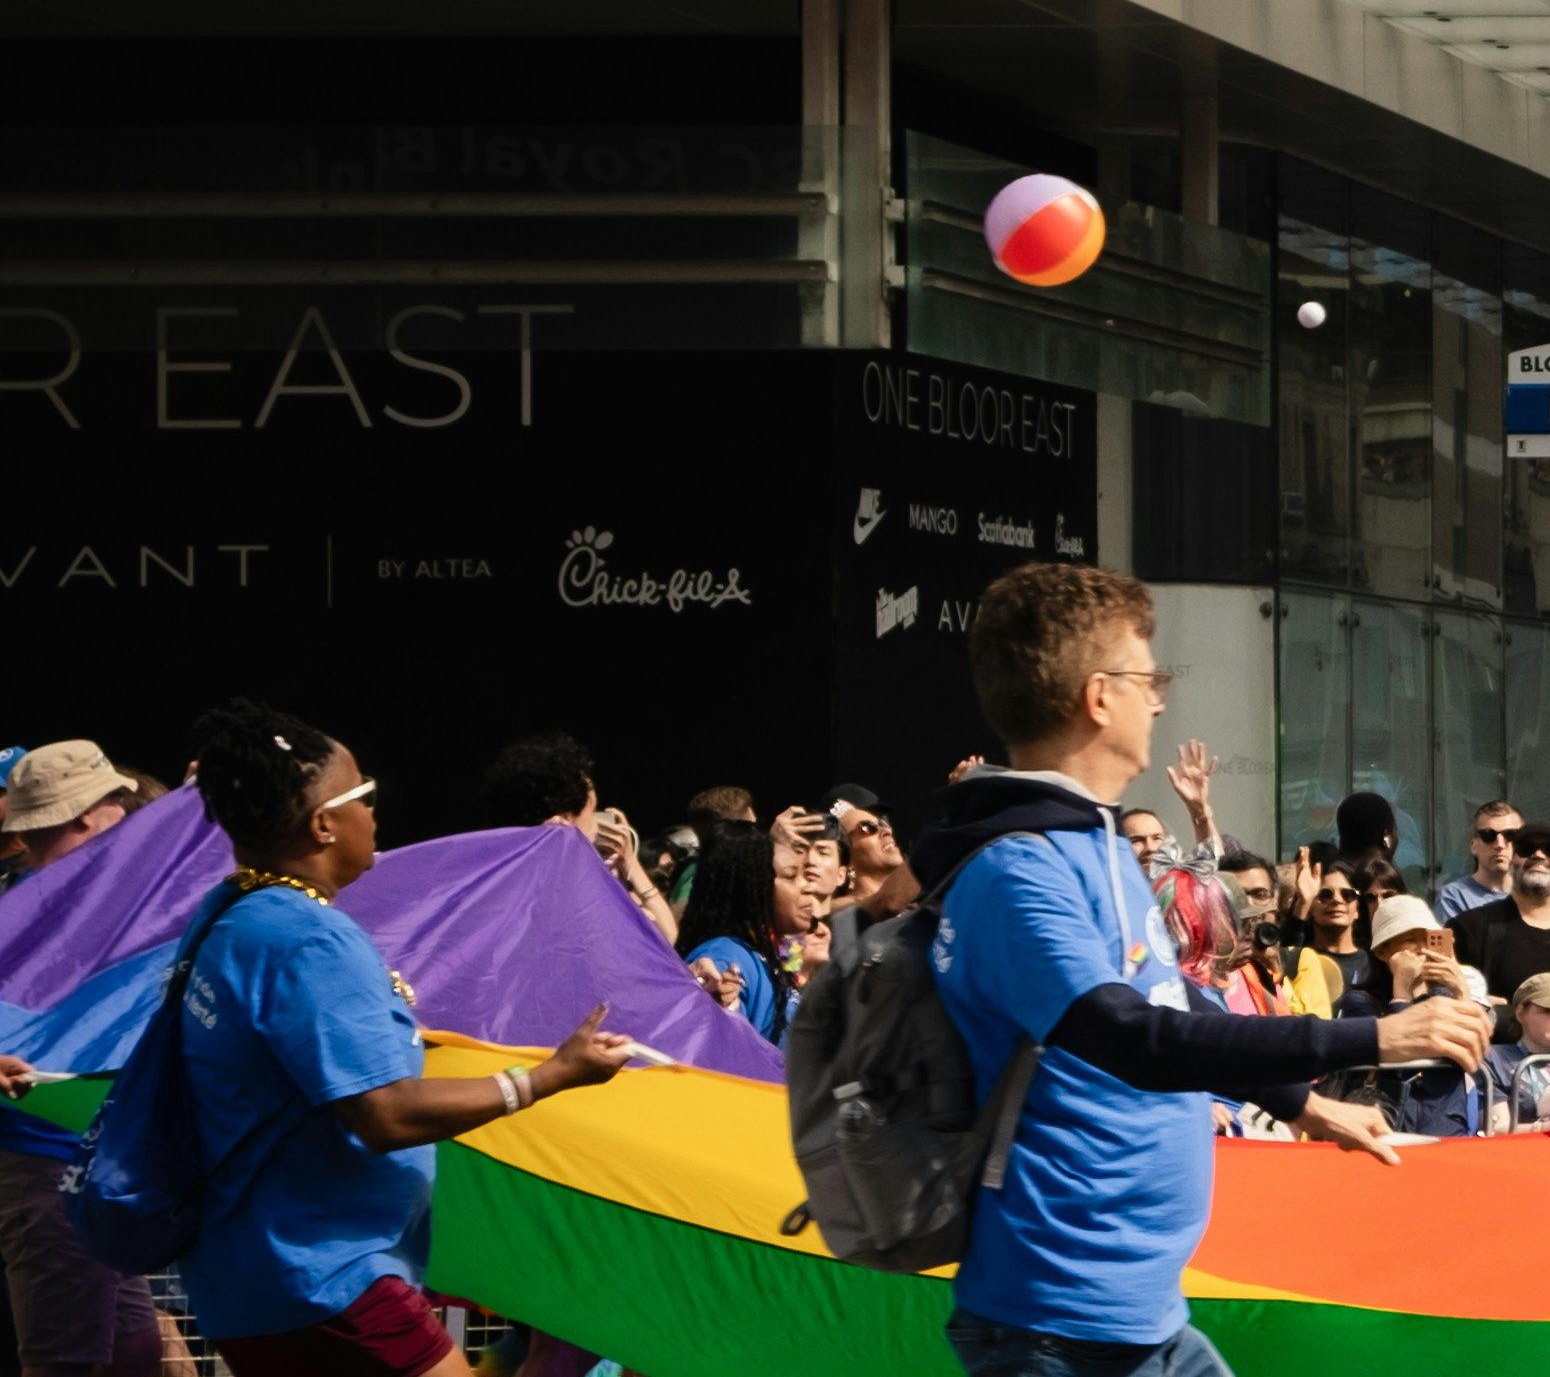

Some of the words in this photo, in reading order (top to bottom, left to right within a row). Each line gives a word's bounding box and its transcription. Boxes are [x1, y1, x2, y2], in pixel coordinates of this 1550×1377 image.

[156, 304, 575, 429] EAST
[863, 361, 920, 430] ONE
[929, 374, 1015, 448] BLOOR
[1022, 394, 1076, 460] EAST
[909, 503, 958, 536] MANGO
[978, 511, 1035, 549] Scotiabank
[378, 560, 406, 579] BY
[415, 559, 493, 579] ALTEA
[558, 540, 751, 612] Chick-fil-A
